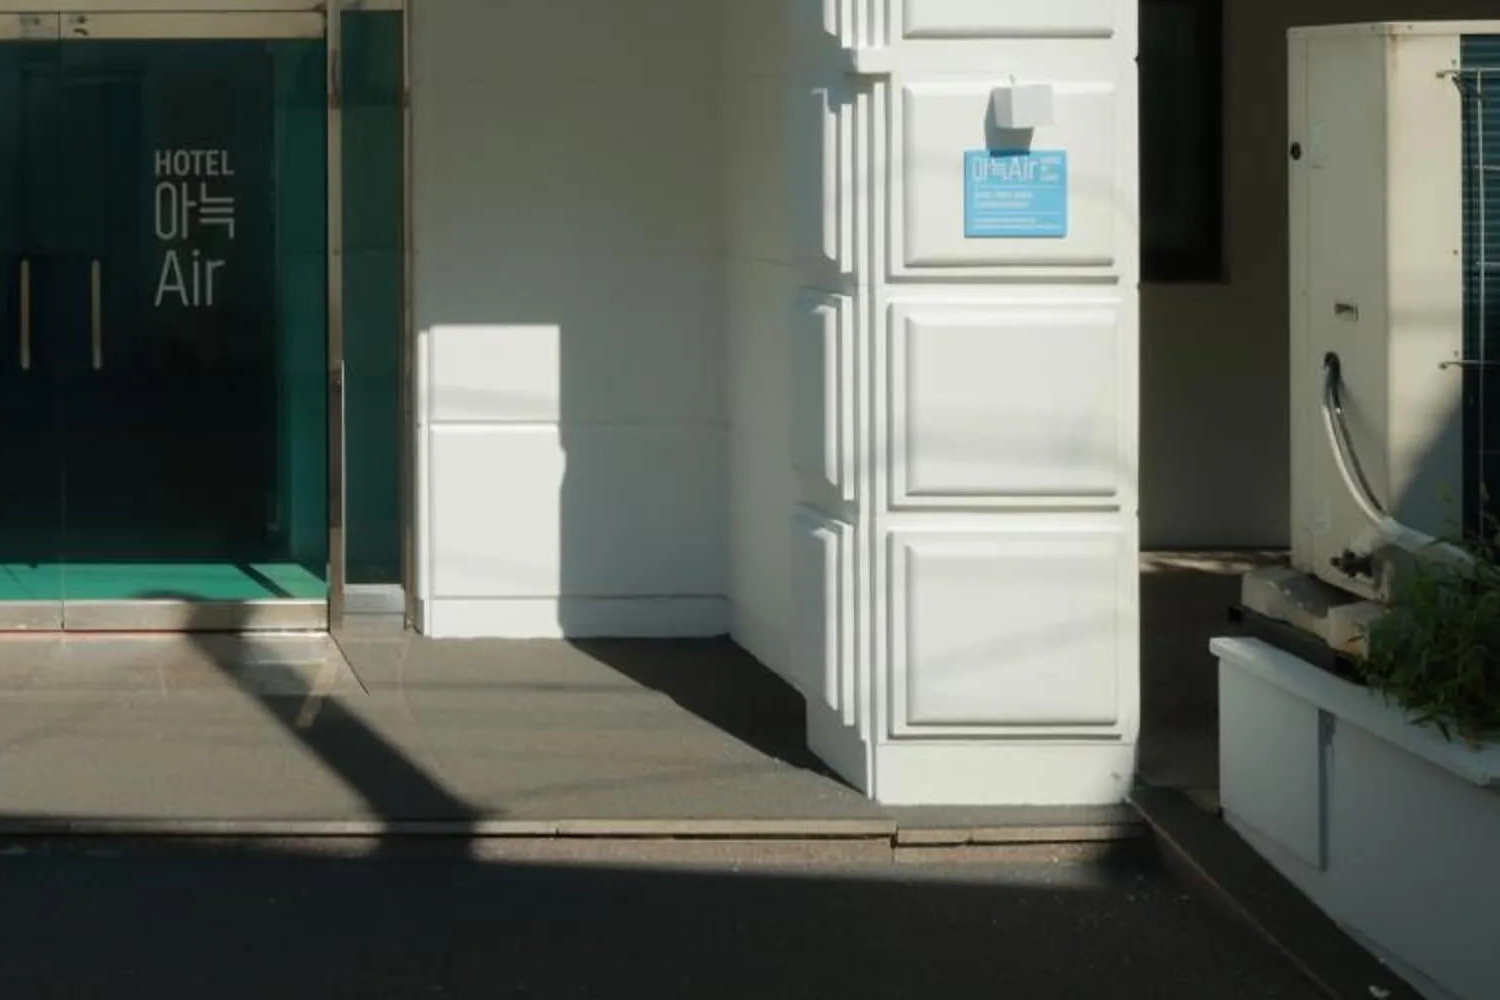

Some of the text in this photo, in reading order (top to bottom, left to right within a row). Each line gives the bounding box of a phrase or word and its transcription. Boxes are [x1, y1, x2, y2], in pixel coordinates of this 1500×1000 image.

[155, 149, 235, 176] HOTEL
[155, 182, 235, 240] 아늑
[155, 249, 226, 308] Air
